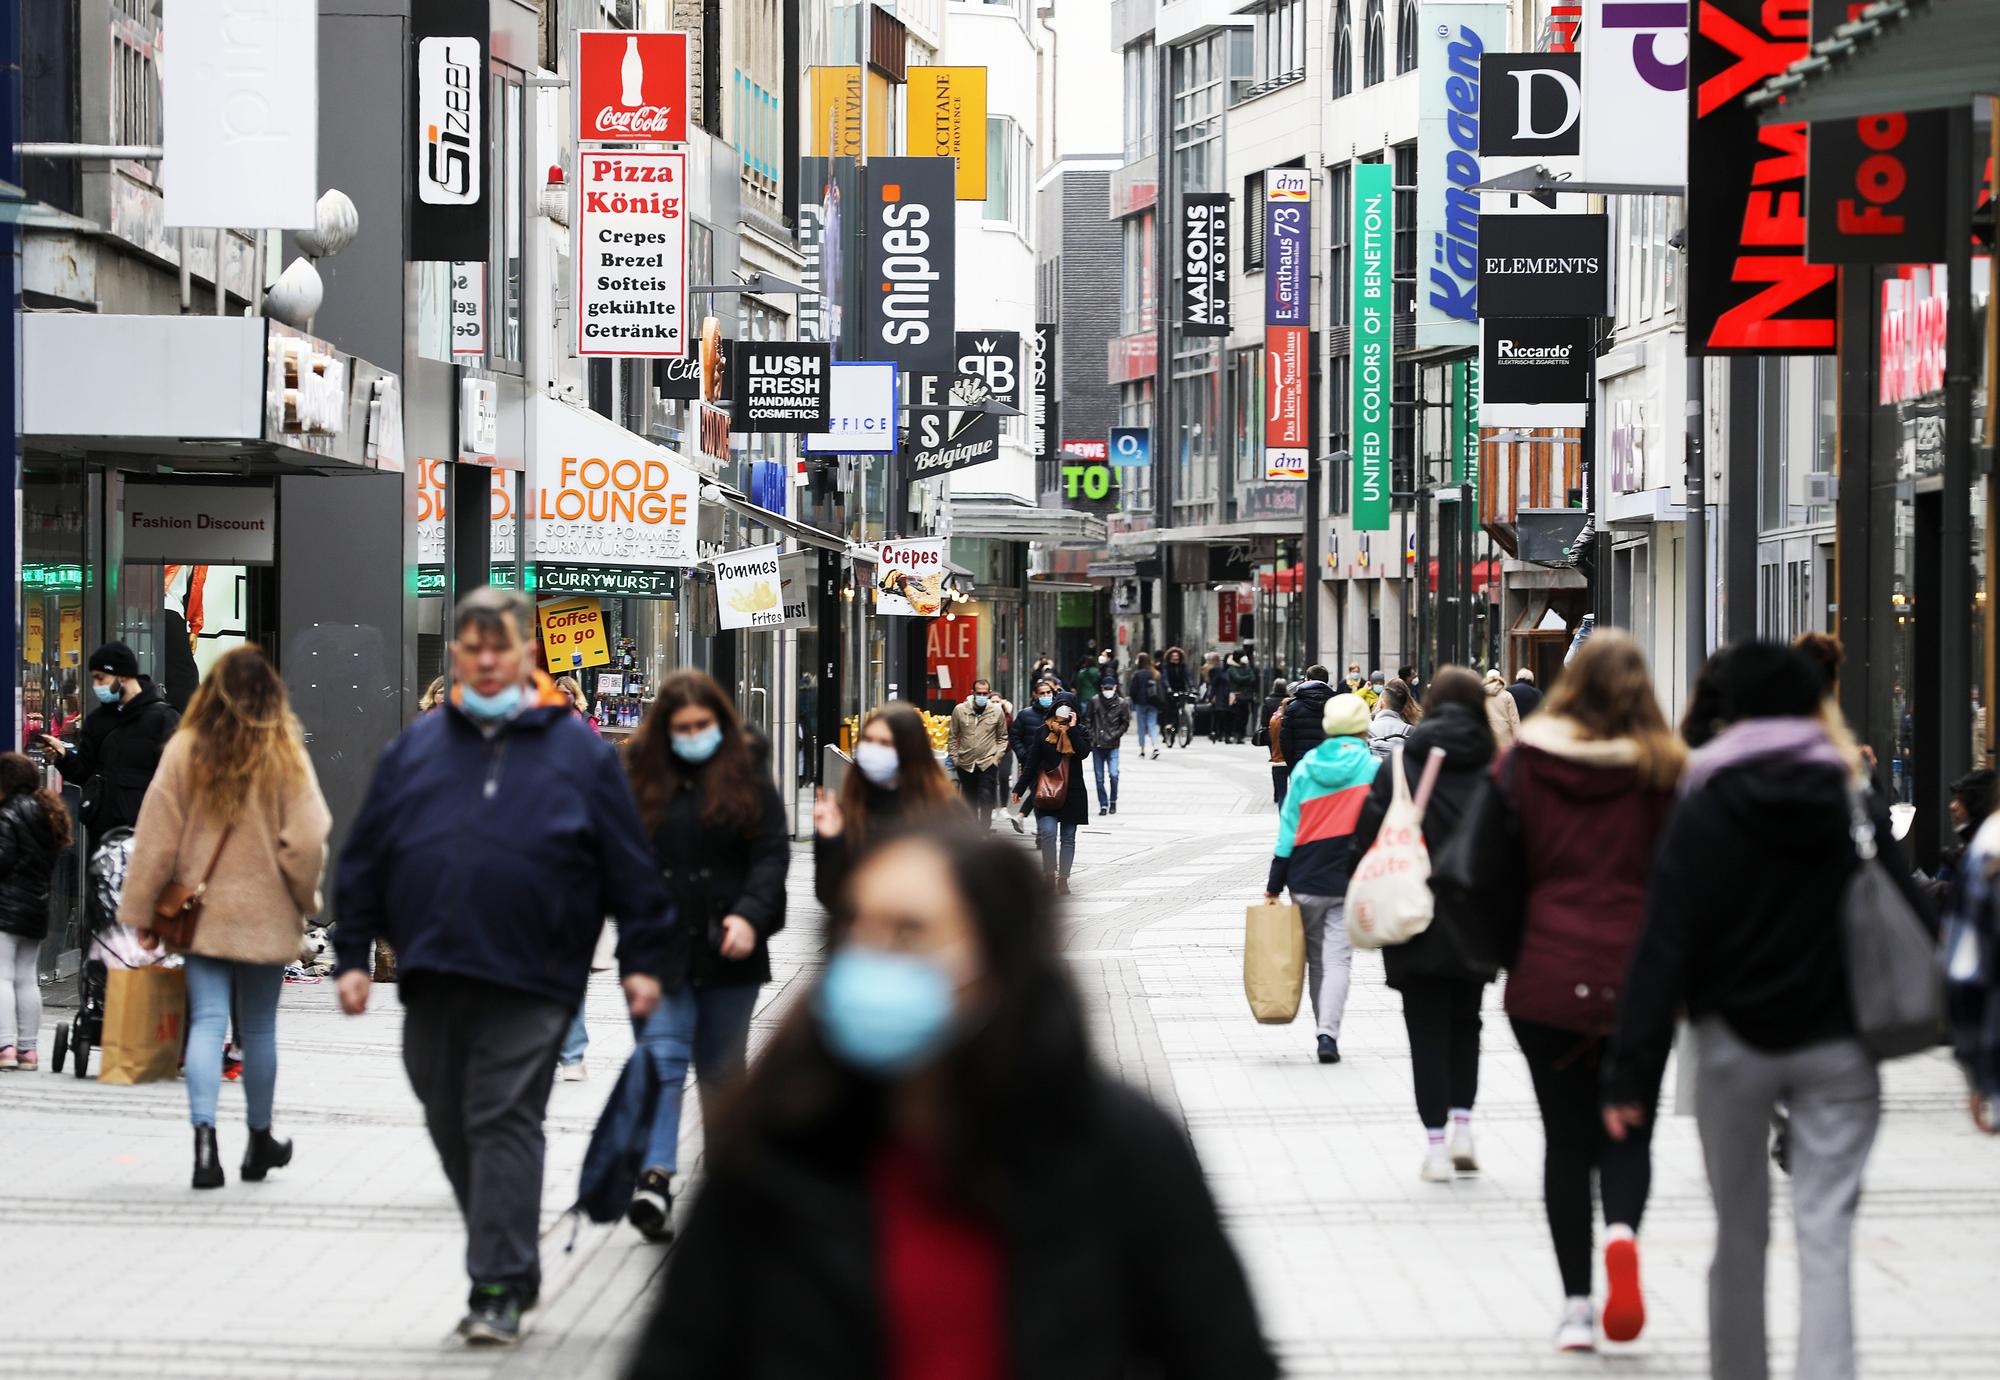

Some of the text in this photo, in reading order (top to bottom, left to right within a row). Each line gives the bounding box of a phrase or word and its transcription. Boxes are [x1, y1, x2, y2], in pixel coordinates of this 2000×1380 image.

[1507, 68, 1581, 139] D
[428, 46, 470, 197] Sizeer
[595, 106, 671, 132] Coca-Cola
[592, 160, 674, 183] Pizza
[1277, 174, 1304, 190] dm
[586, 191, 679, 218] König
[599, 229, 666, 245] Crepes
[600, 253, 663, 267] Brezel
[1187, 205, 1208, 324] MAISONS
[1214, 205, 1226, 324] DU MONDE
[1485, 258, 1599, 274] ELEMENTS
[597, 276, 666, 291] Softeis
[882, 203, 940, 345] snipes
[588, 299, 676, 316] gekühlte
[585, 323, 678, 339] Getränke
[1363, 193, 1382, 501] UNITED COLORS OF BENETTON.
[1498, 340, 1571, 358] Riccardo
[749, 355, 820, 375] LUSH
[749, 377, 820, 394] FRESH
[1283, 331, 1296, 442] Das kleine Steakhaus
[749, 397, 820, 407] HANDMADE
[749, 408, 820, 419] COSMETICS
[914, 439, 993, 471] Belgique
[1275, 453, 1302, 468] dm
[561, 457, 669, 491] FOOD
[540, 488, 687, 524] LOUNGE
[132, 512, 265, 530] Fashion Discount
[615, 526, 681, 542] POMMES
[536, 539, 639, 558] CURRYWURST
[649, 544, 690, 559] PIZZA
[717, 560, 777, 580] Pommes
[546, 612, 598, 629] Coffee
[752, 611, 782, 626] Frites
[549, 628, 595, 645] to go
[927, 623, 970, 658] ALE
